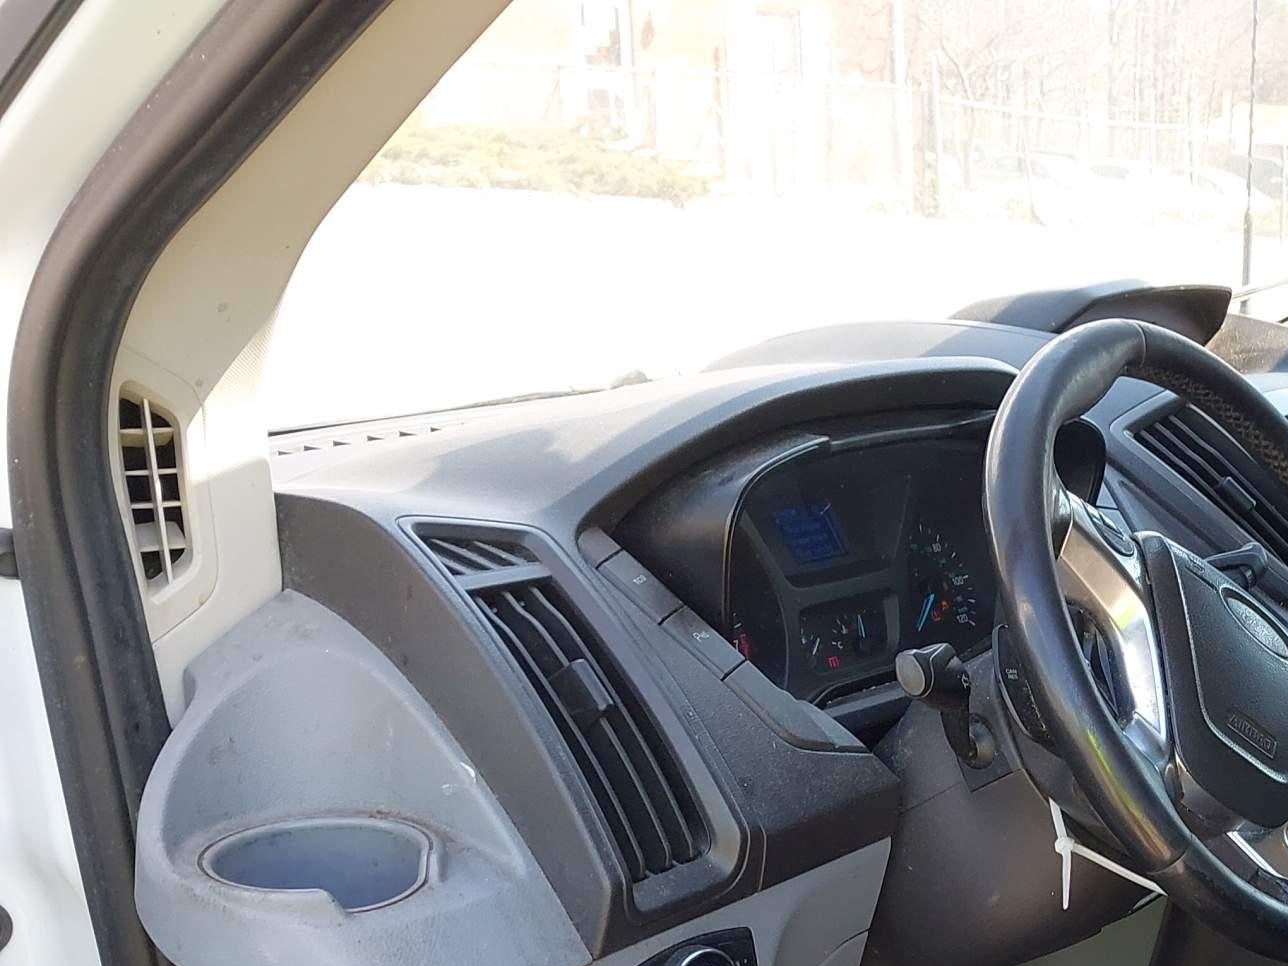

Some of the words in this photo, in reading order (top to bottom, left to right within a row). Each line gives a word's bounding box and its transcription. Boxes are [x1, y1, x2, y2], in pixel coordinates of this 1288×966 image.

[952, 576, 964, 586] 100
[957, 613, 969, 624] 120
[1234, 718, 1271, 751] AIRBAG
